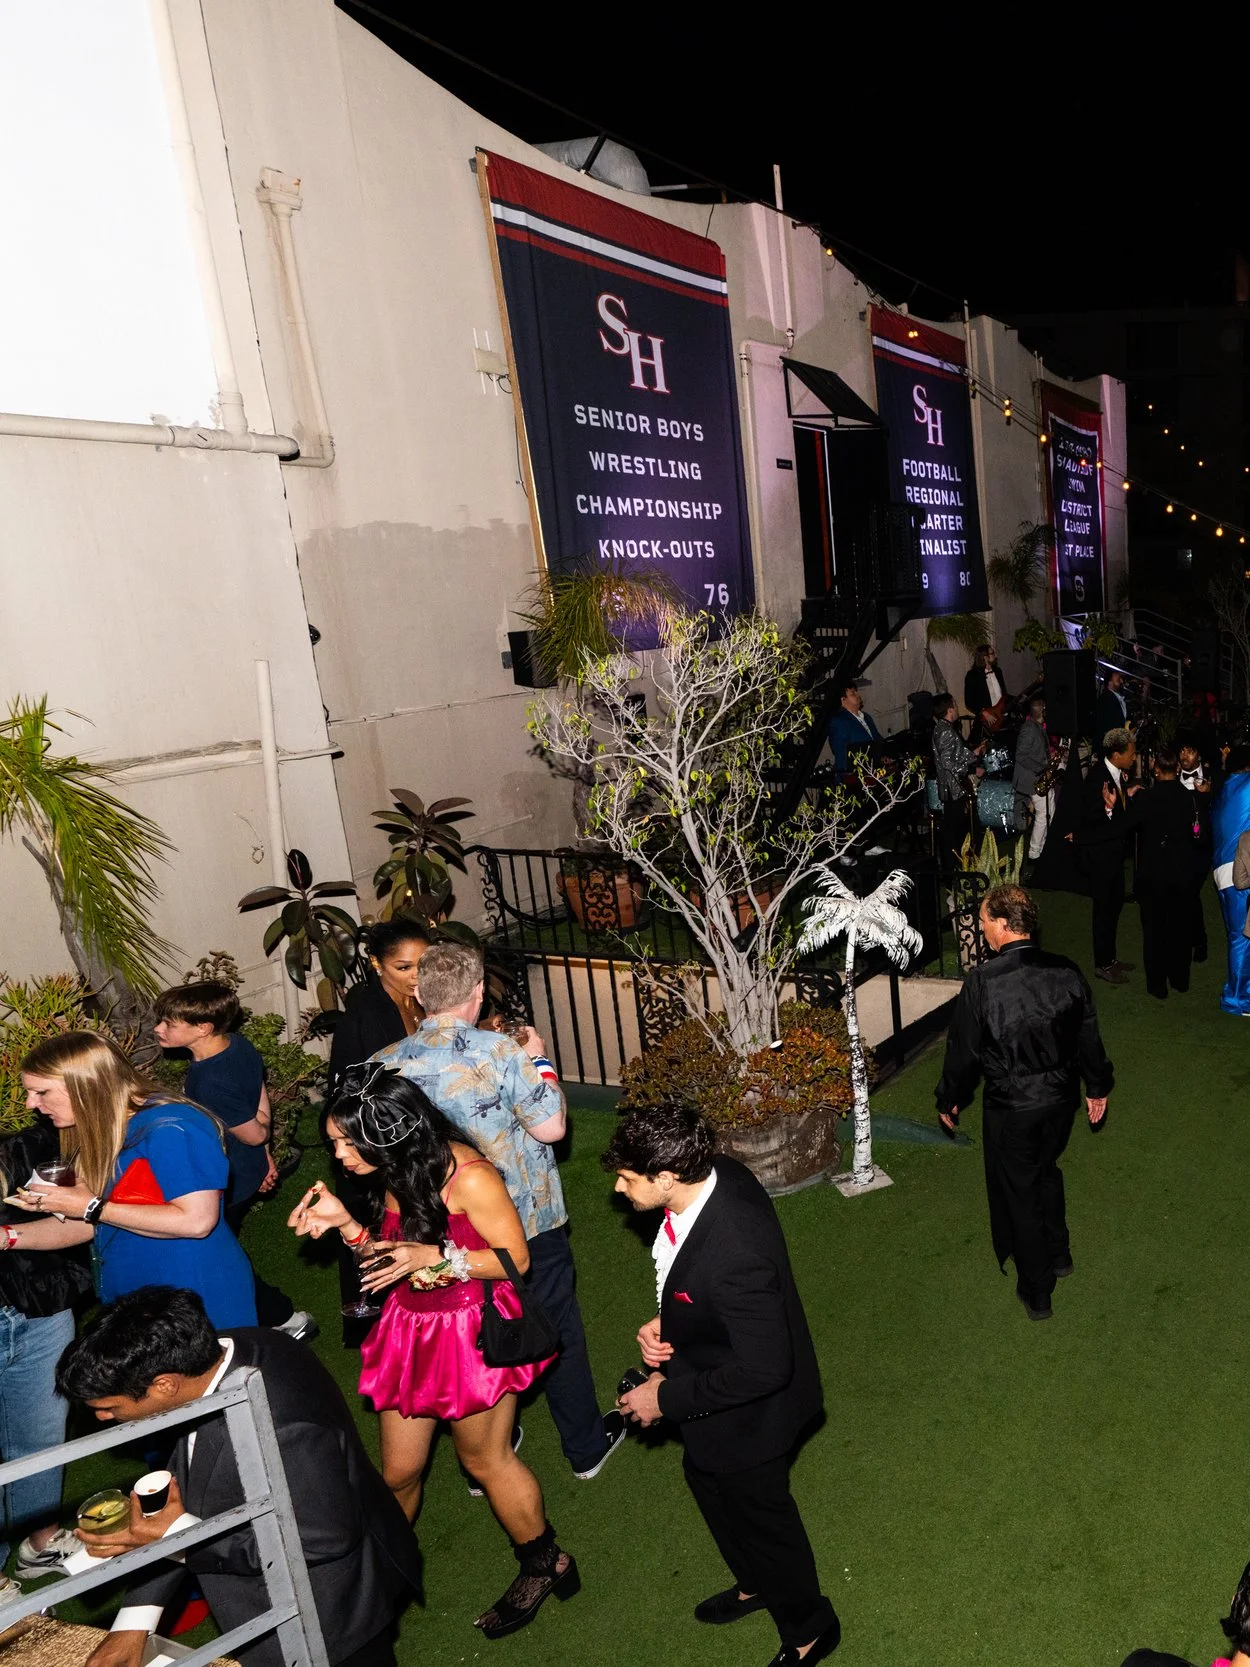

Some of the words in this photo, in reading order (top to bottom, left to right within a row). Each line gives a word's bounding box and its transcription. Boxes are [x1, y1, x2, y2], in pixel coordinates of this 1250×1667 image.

[574, 404, 651, 435] SENIOR
[657, 418, 704, 442] BOYS
[589, 451, 702, 481] WRESTLING
[903, 458, 962, 482] FOOTBALL
[576, 494, 722, 521] CHAMPIONSHIP
[905, 486, 964, 507] REGIONAL
[1061, 499, 1093, 517] DSTRICT
[912, 513, 964, 531] ARTER
[599, 539, 715, 559] KNOCK-OUTS
[919, 539, 967, 556] INALIST
[704, 583, 730, 606] 76
